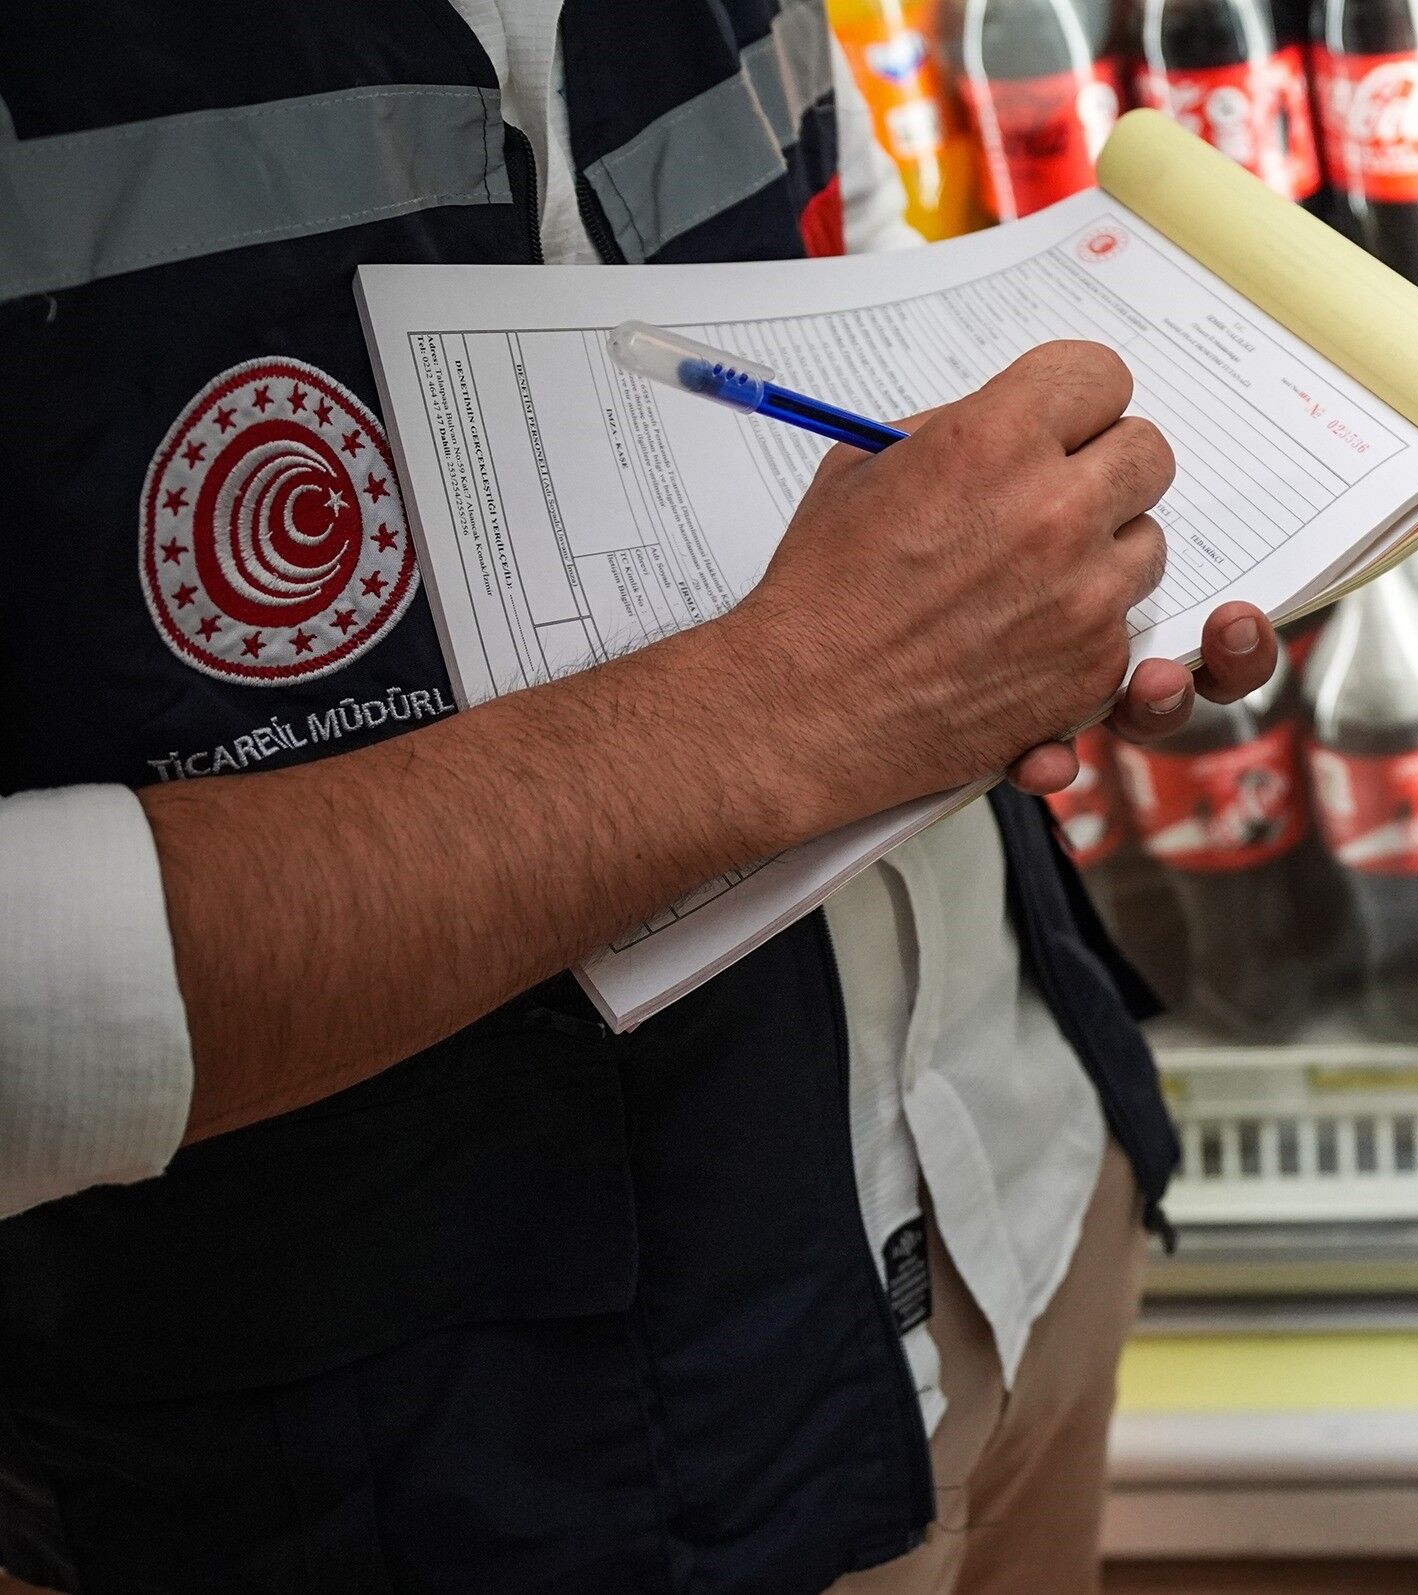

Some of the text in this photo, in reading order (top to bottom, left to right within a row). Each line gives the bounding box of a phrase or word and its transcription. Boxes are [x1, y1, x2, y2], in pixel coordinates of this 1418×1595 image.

[416, 336, 469, 536] Tel: 0232 464 47 47 Dahili: 253/254/255/256
[426, 334, 439, 365] Adres:
[434, 368, 449, 410] Talatpaşa
[453, 446, 465, 474] No:59
[459, 475, 471, 498] Kat:7
[465, 501, 480, 540] Alsancak
[454, 360, 475, 422] DENETİMİN
[469, 425, 498, 515] GERÇEKLEŞTİĞİ
[515, 363, 532, 412] DENETİM
[528, 416, 548, 475] PERSONELİ
